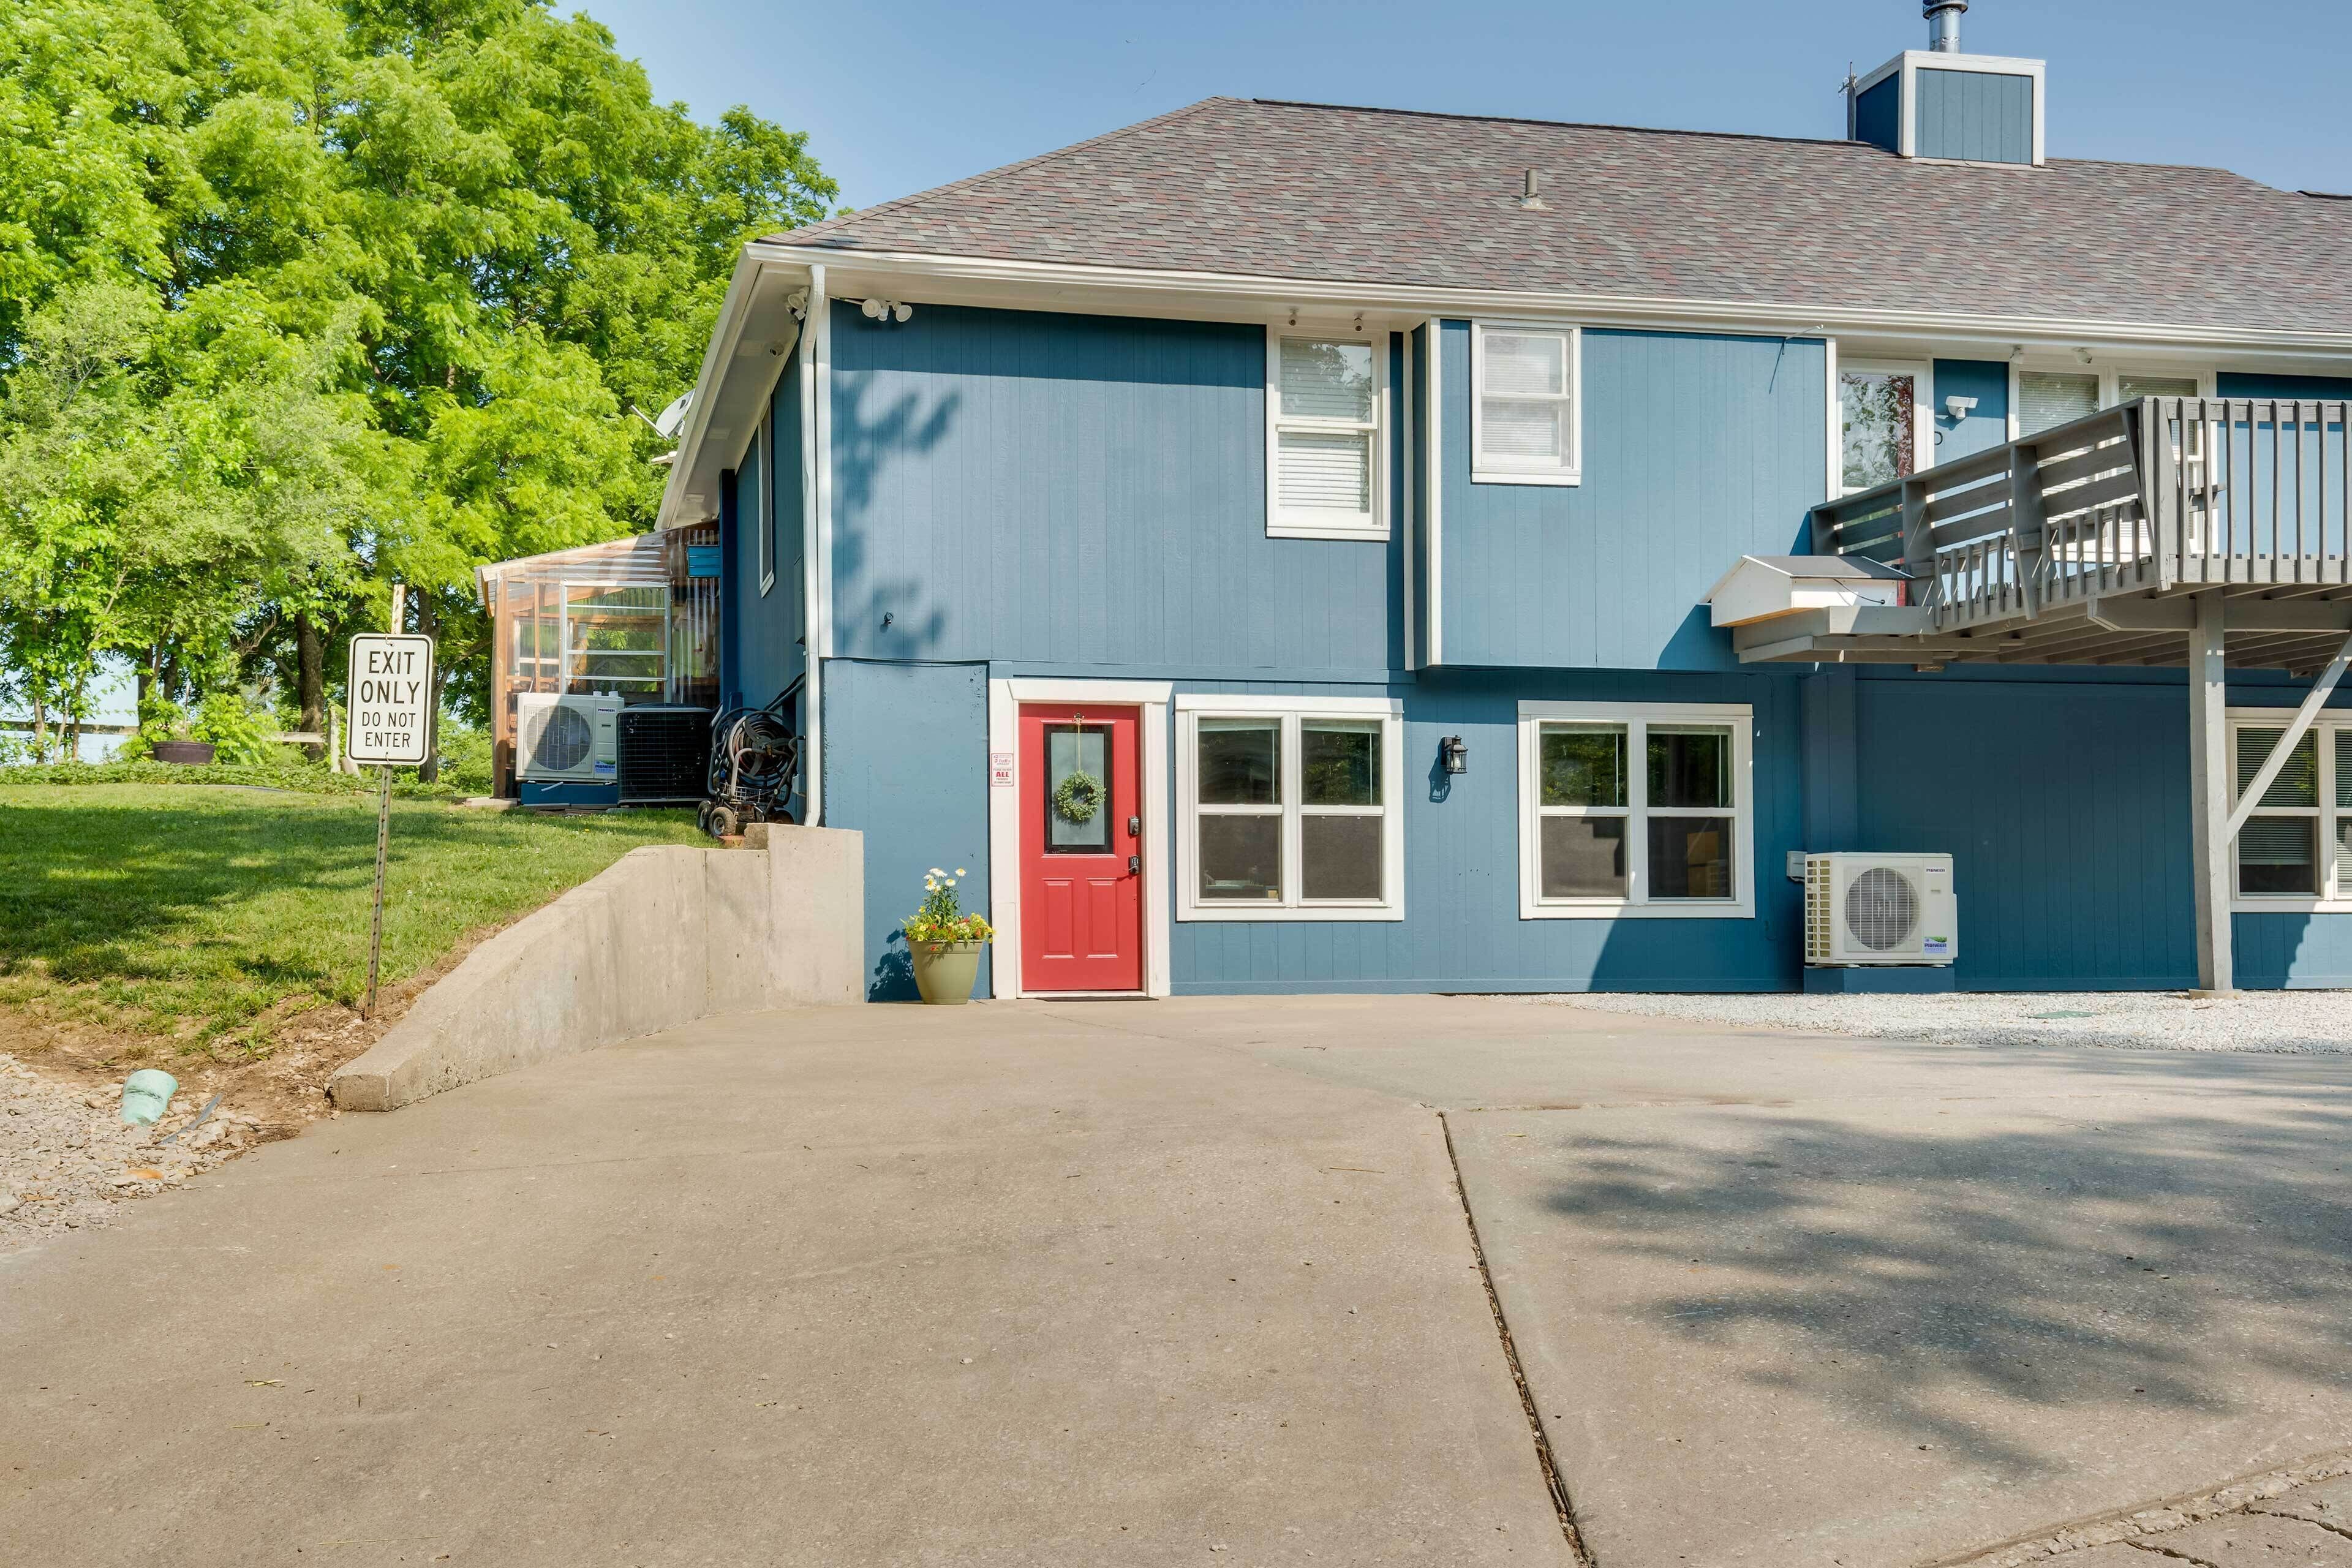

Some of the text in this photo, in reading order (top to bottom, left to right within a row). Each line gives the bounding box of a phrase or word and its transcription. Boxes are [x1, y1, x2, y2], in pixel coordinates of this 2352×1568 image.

[369, 651, 415, 674] EXIT
[361, 680, 420, 704] ONLY
[362, 712, 416, 727] DO NOT
[365, 732, 410, 747] ENTER
